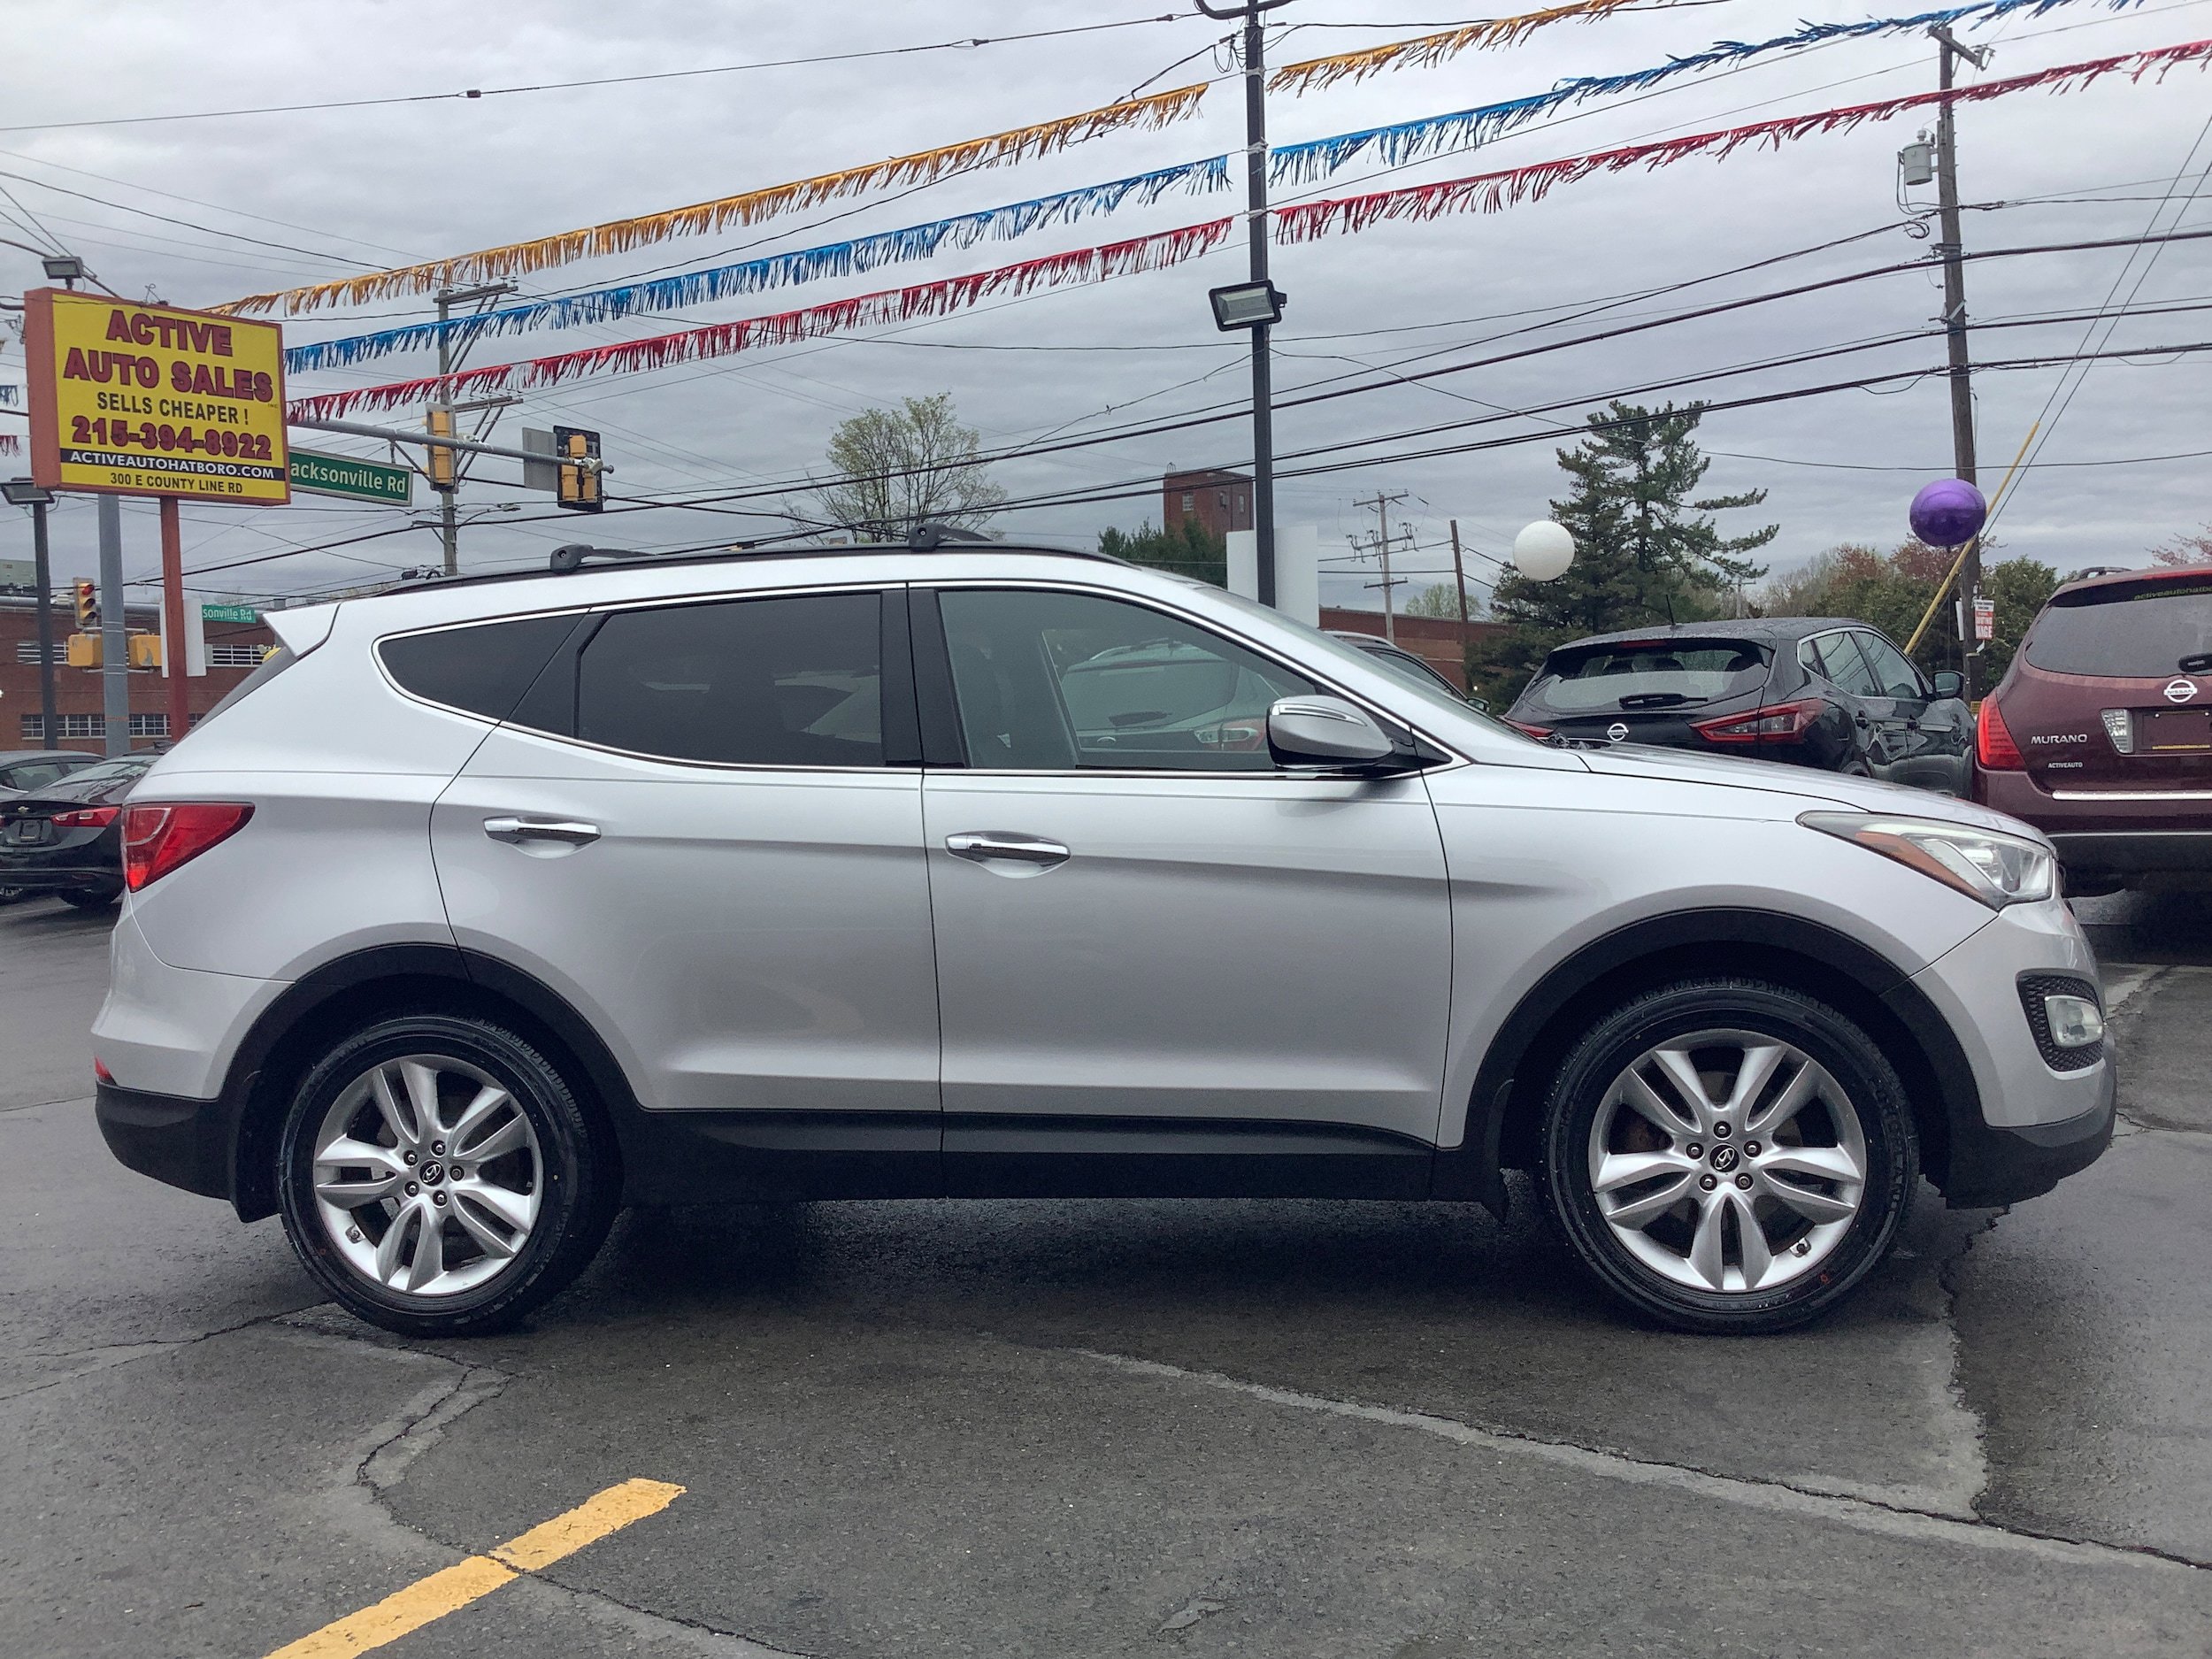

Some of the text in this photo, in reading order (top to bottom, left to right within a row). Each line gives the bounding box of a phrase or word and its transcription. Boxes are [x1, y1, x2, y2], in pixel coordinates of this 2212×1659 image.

[105, 309, 234, 357] ACTIVE
[63, 347, 273, 403] AUTO SALES
[97, 392, 152, 415] SELLS
[158, 398, 239, 425] CHEAPER
[71, 415, 273, 461] 215-394-8922
[70, 450, 274, 480] ACTIVEAUTOHATBORO.COM
[111, 472, 243, 494] 300 E COUNTY LINE RD
[388, 475, 406, 494] Rd
[203, 607, 252, 621] sonville Rd
[2031, 733, 2088, 744] MURANO
